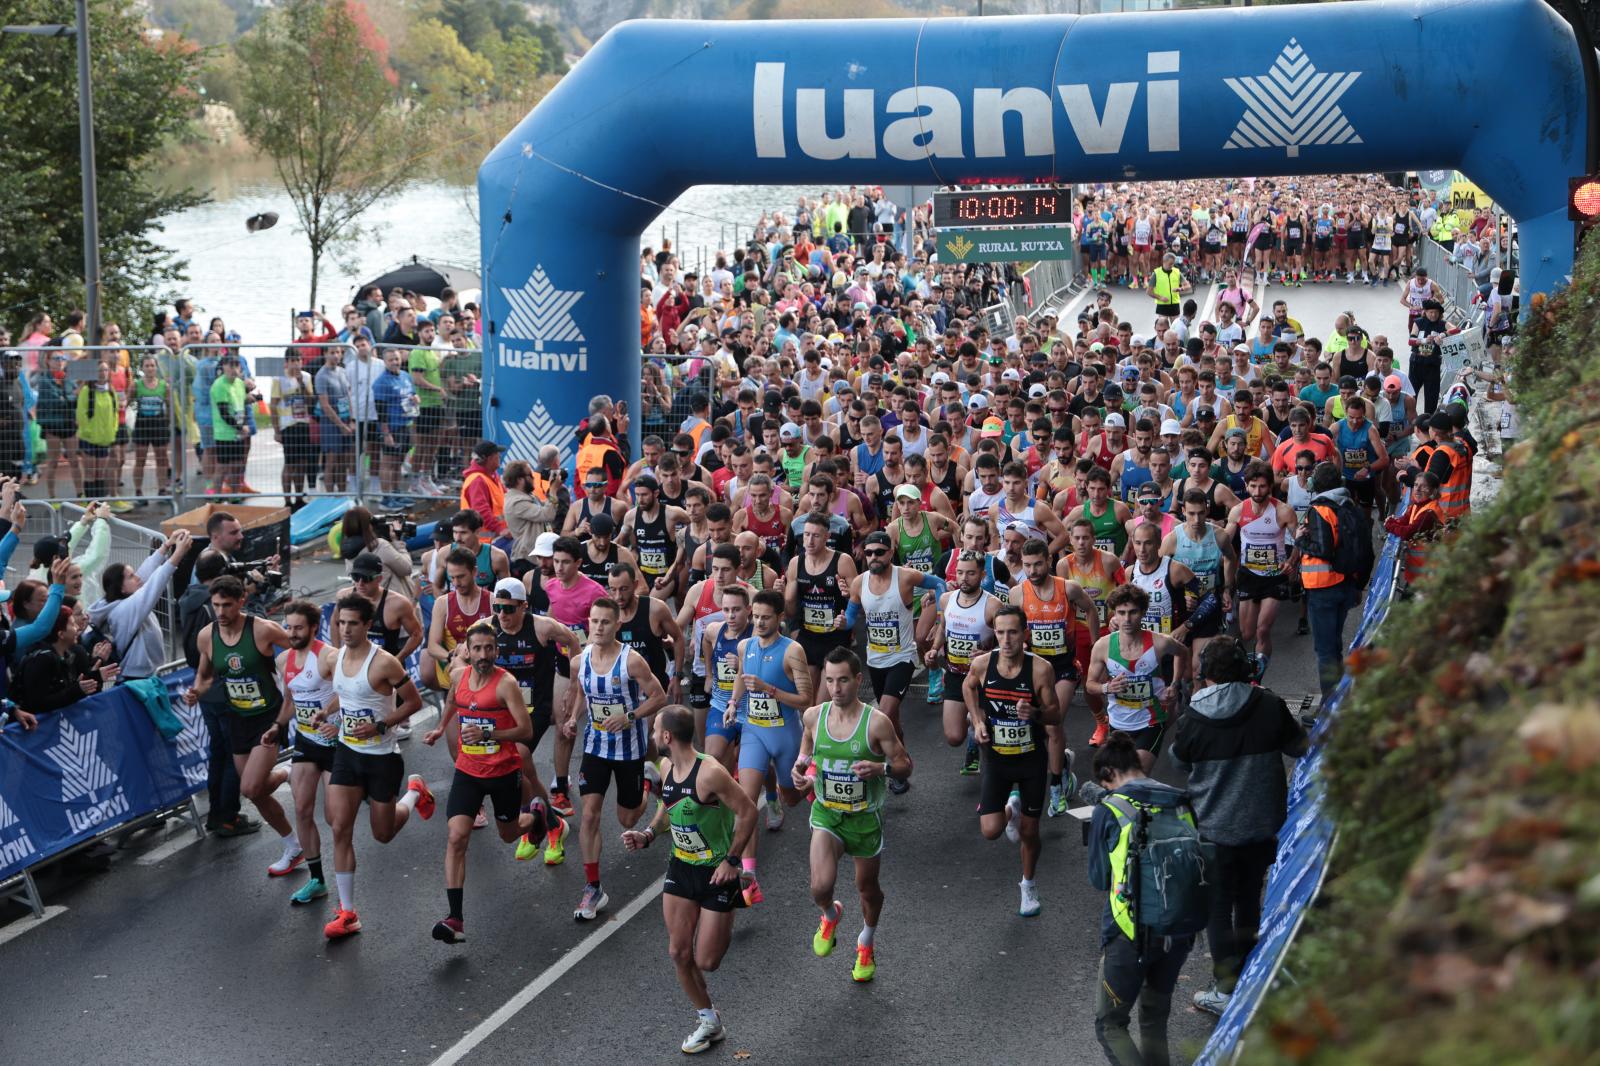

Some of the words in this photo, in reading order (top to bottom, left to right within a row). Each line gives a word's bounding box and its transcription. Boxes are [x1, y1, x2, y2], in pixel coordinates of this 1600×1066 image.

[753, 50, 1181, 161] luanvi
[959, 196, 1057, 220] 10:00:14
[978, 242, 1018, 253] RURAL
[1021, 240, 1064, 251] KUTXA
[498, 342, 588, 372] luanvi
[643, 553, 661, 562] 372
[1253, 550, 1268, 559] 64
[811, 610, 825, 619] 29
[872, 628, 893, 638] 359
[1035, 631, 1060, 641] 305
[951, 640, 974, 651] 222
[231, 684, 255, 694] 115
[602, 706, 611, 716] 6
[753, 700, 769, 711] 24
[999, 727, 1027, 739] 186
[834, 783, 854, 795] 66
[65, 786, 130, 835] luanvi
[675, 832, 692, 845] 98
